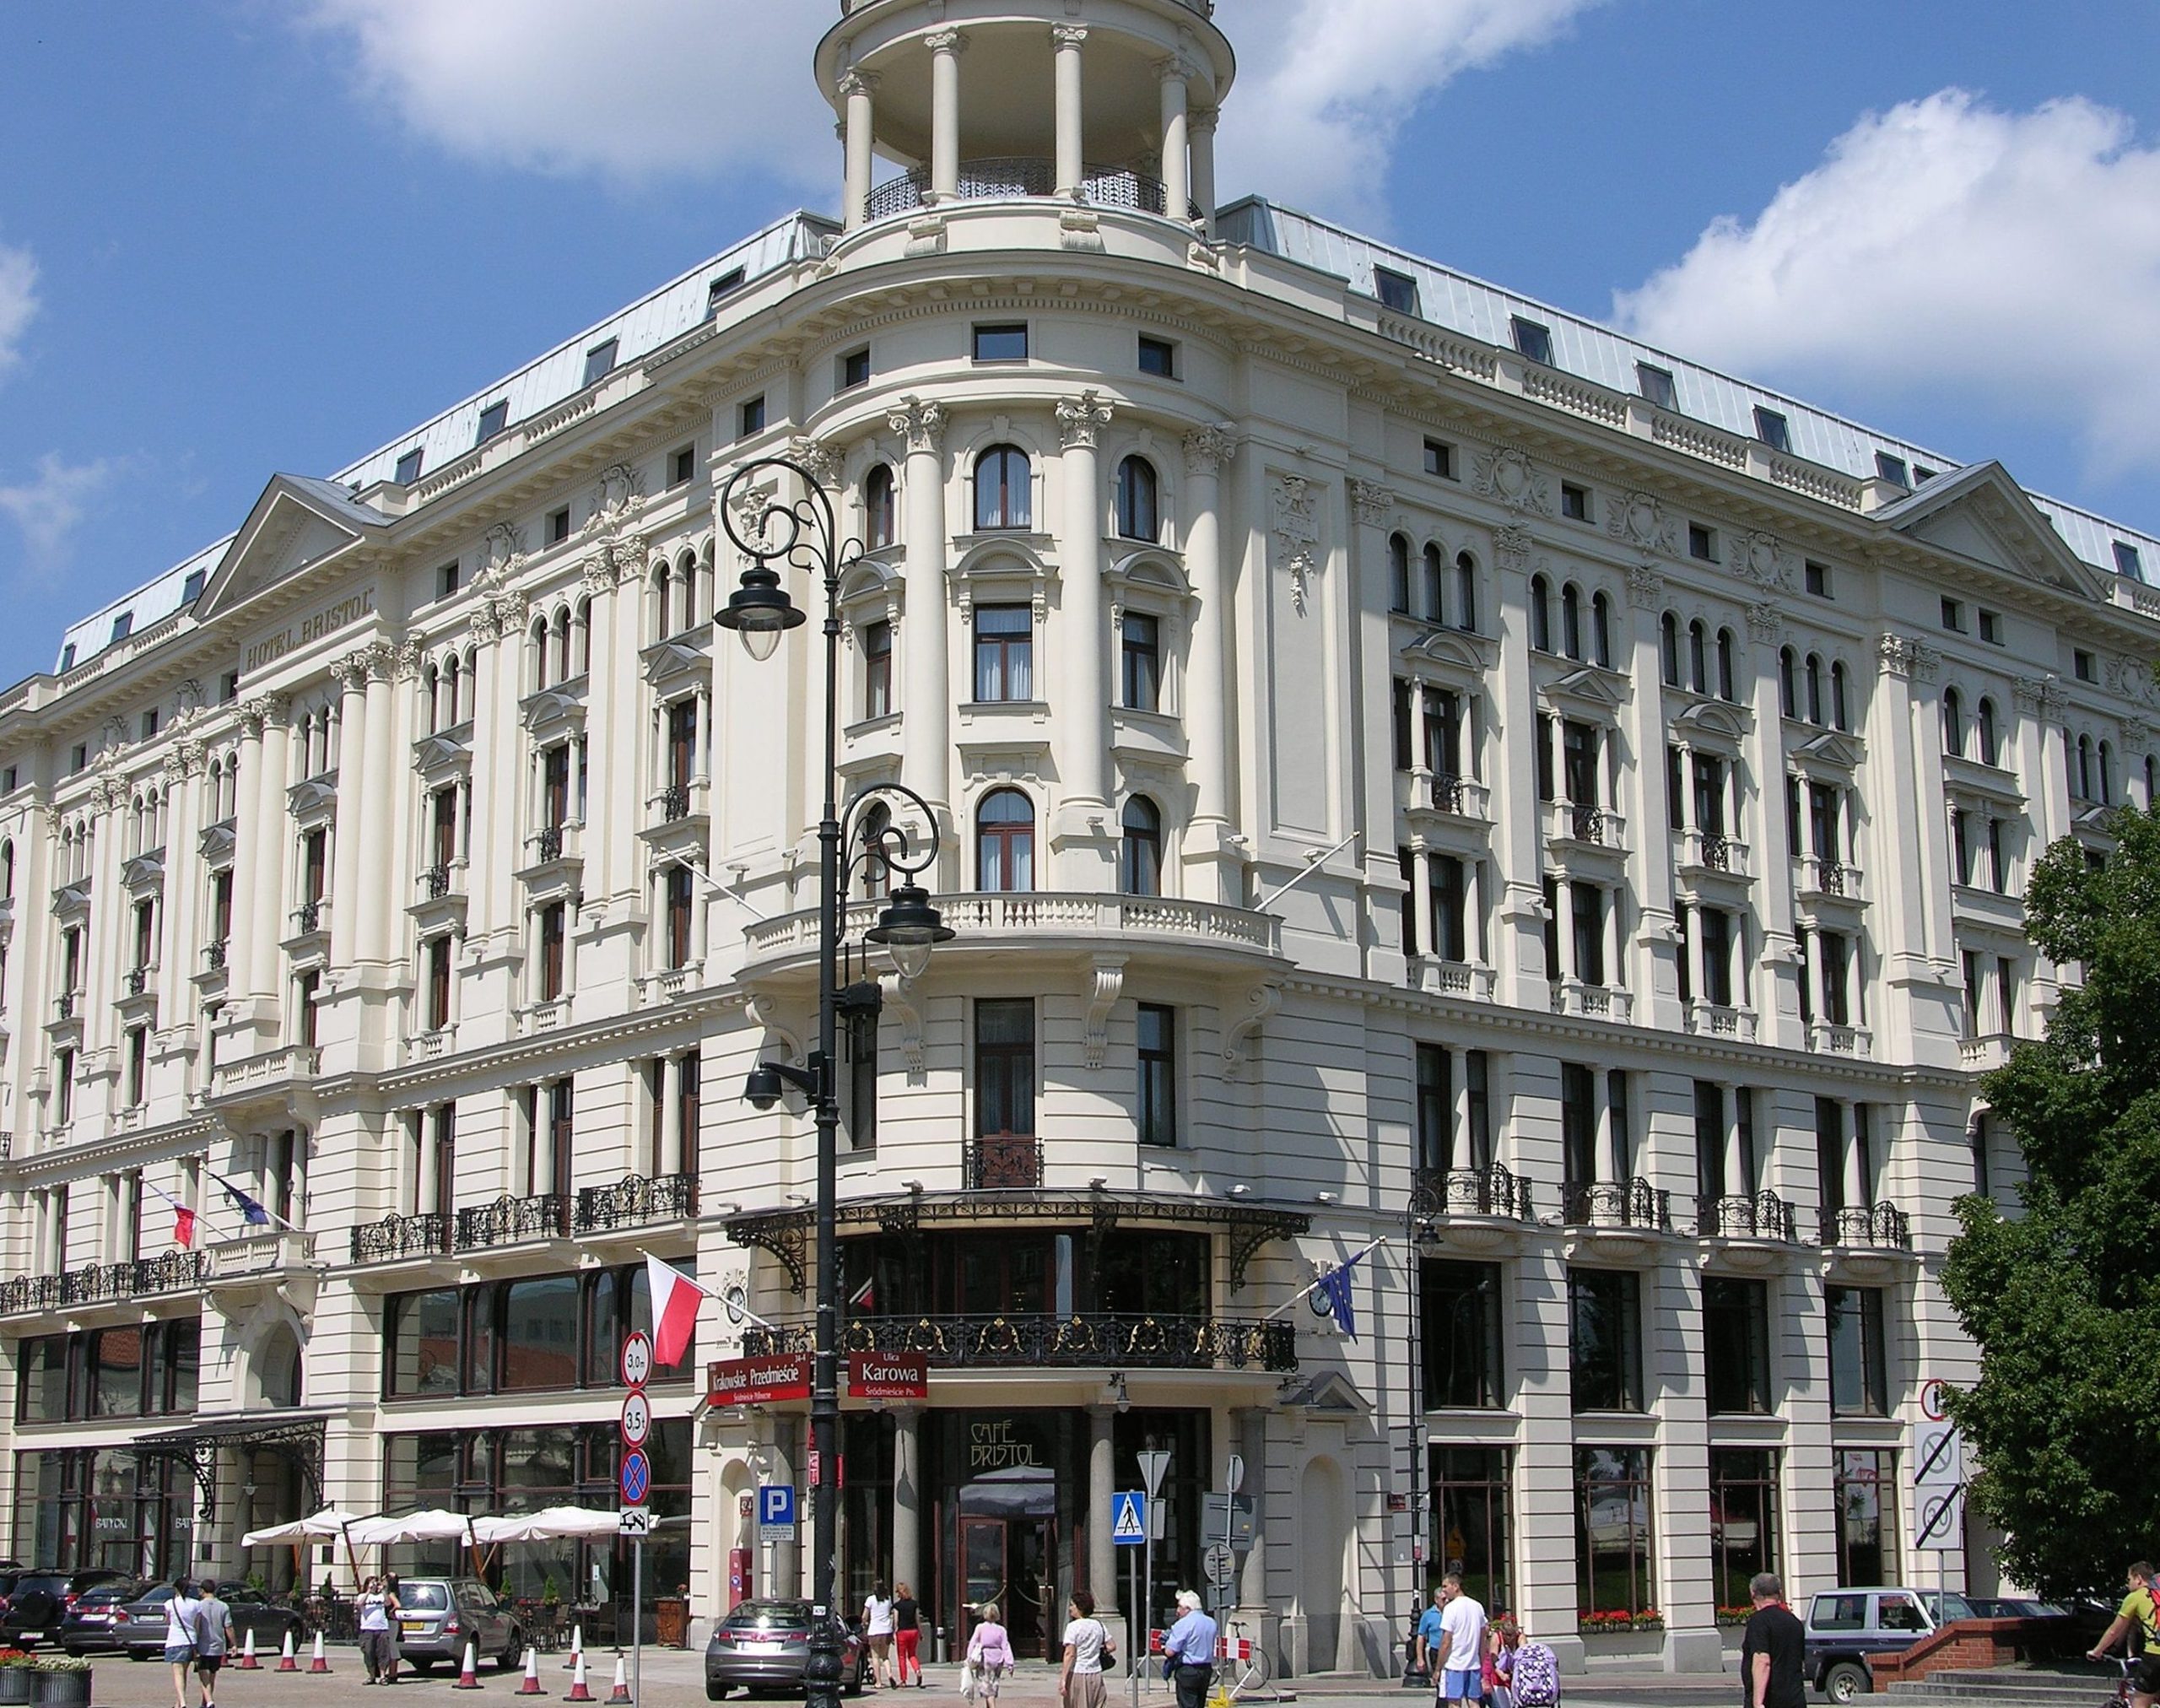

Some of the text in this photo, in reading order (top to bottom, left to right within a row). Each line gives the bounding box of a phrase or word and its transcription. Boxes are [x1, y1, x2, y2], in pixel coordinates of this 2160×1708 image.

[246, 629, 295, 672] HOTEL
[883, 1353, 900, 1362] Ulica
[712, 1364, 799, 1392] Krakowskie Przedmieście
[861, 1362, 919, 1381] Karowa
[865, 1385, 904, 1396] Śródmieście
[970, 1419, 1017, 1444] CAFÉ
[970, 1444, 1044, 1467] BRISTOL
[767, 1489, 787, 1520] P
